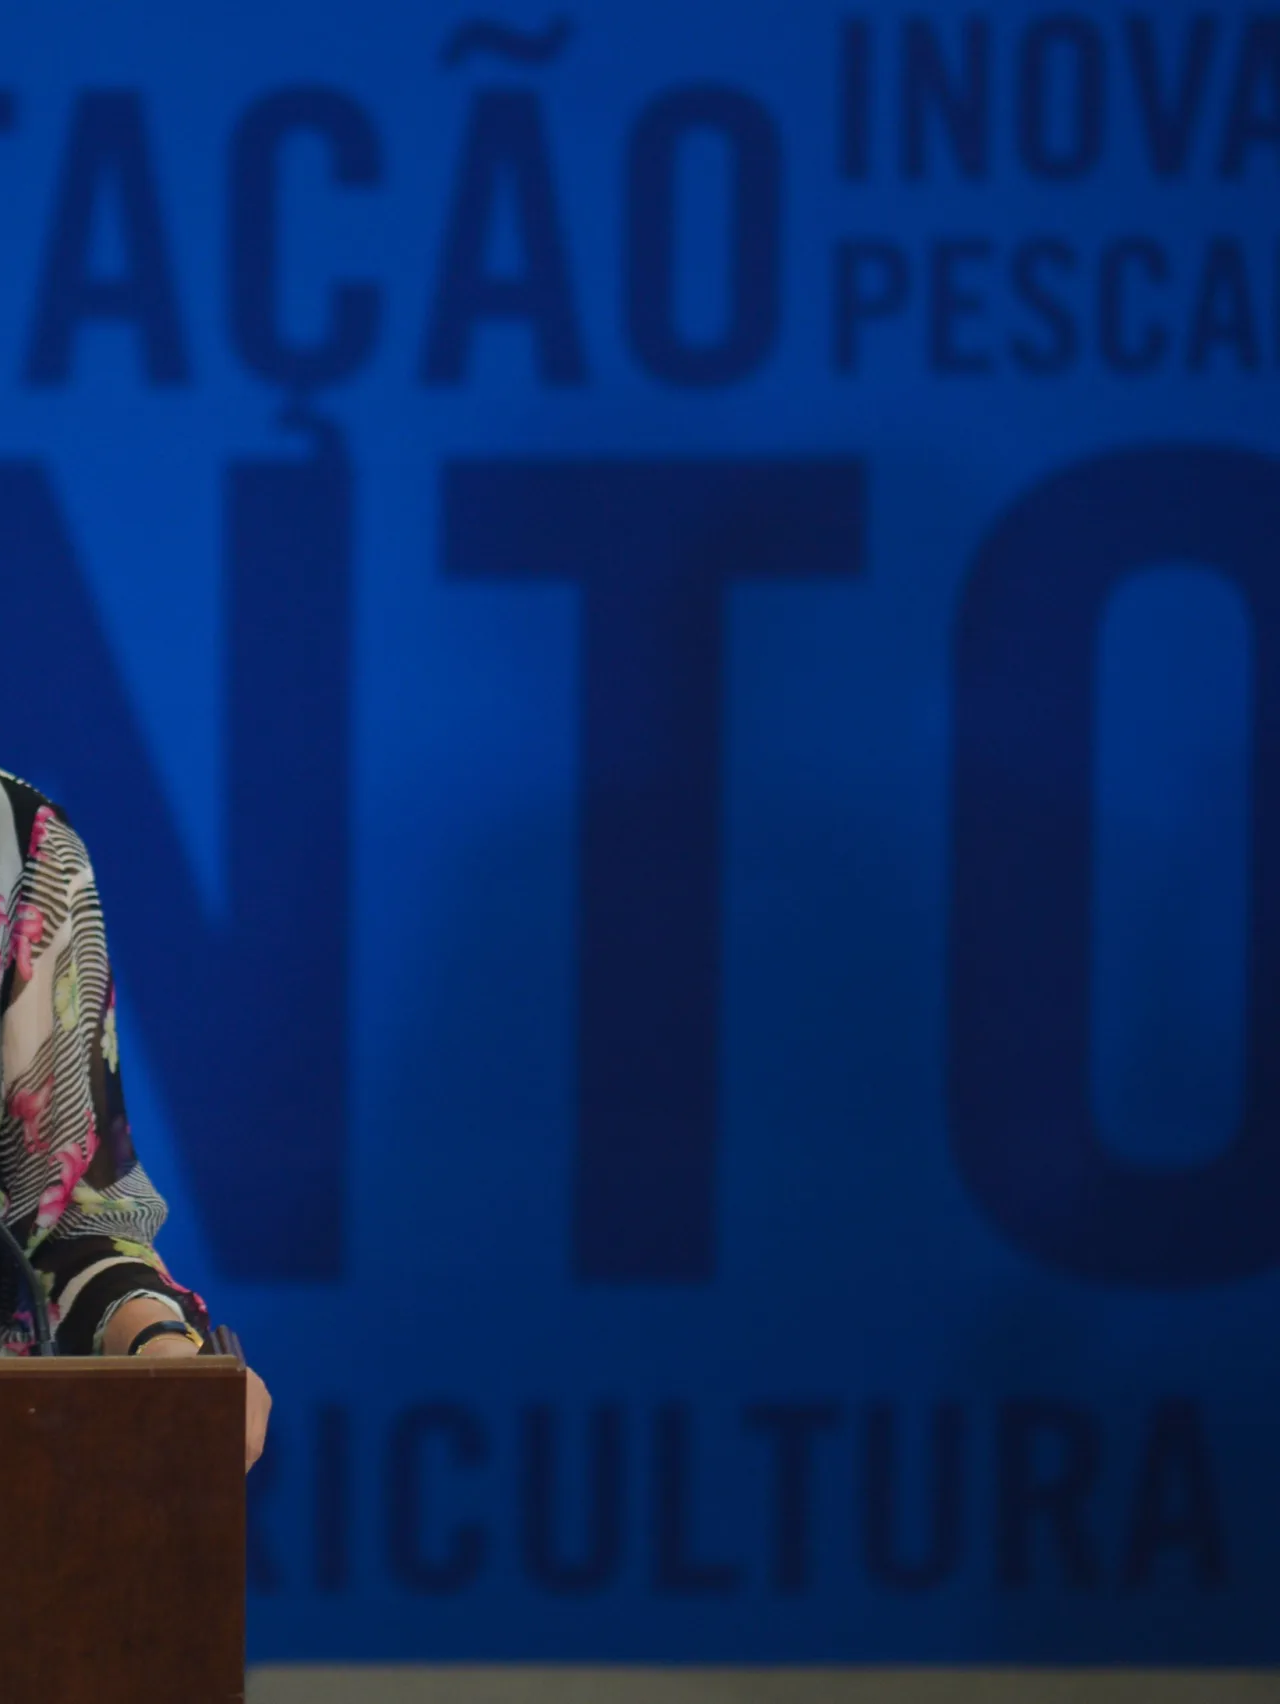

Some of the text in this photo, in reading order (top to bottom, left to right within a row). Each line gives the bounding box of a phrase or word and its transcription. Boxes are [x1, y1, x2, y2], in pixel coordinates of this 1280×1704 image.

[841, 14, 1280, 180] INOVA
[834, 234, 1280, 376] PESCA
[246, 1398, 1230, 1595] ICULTURA
